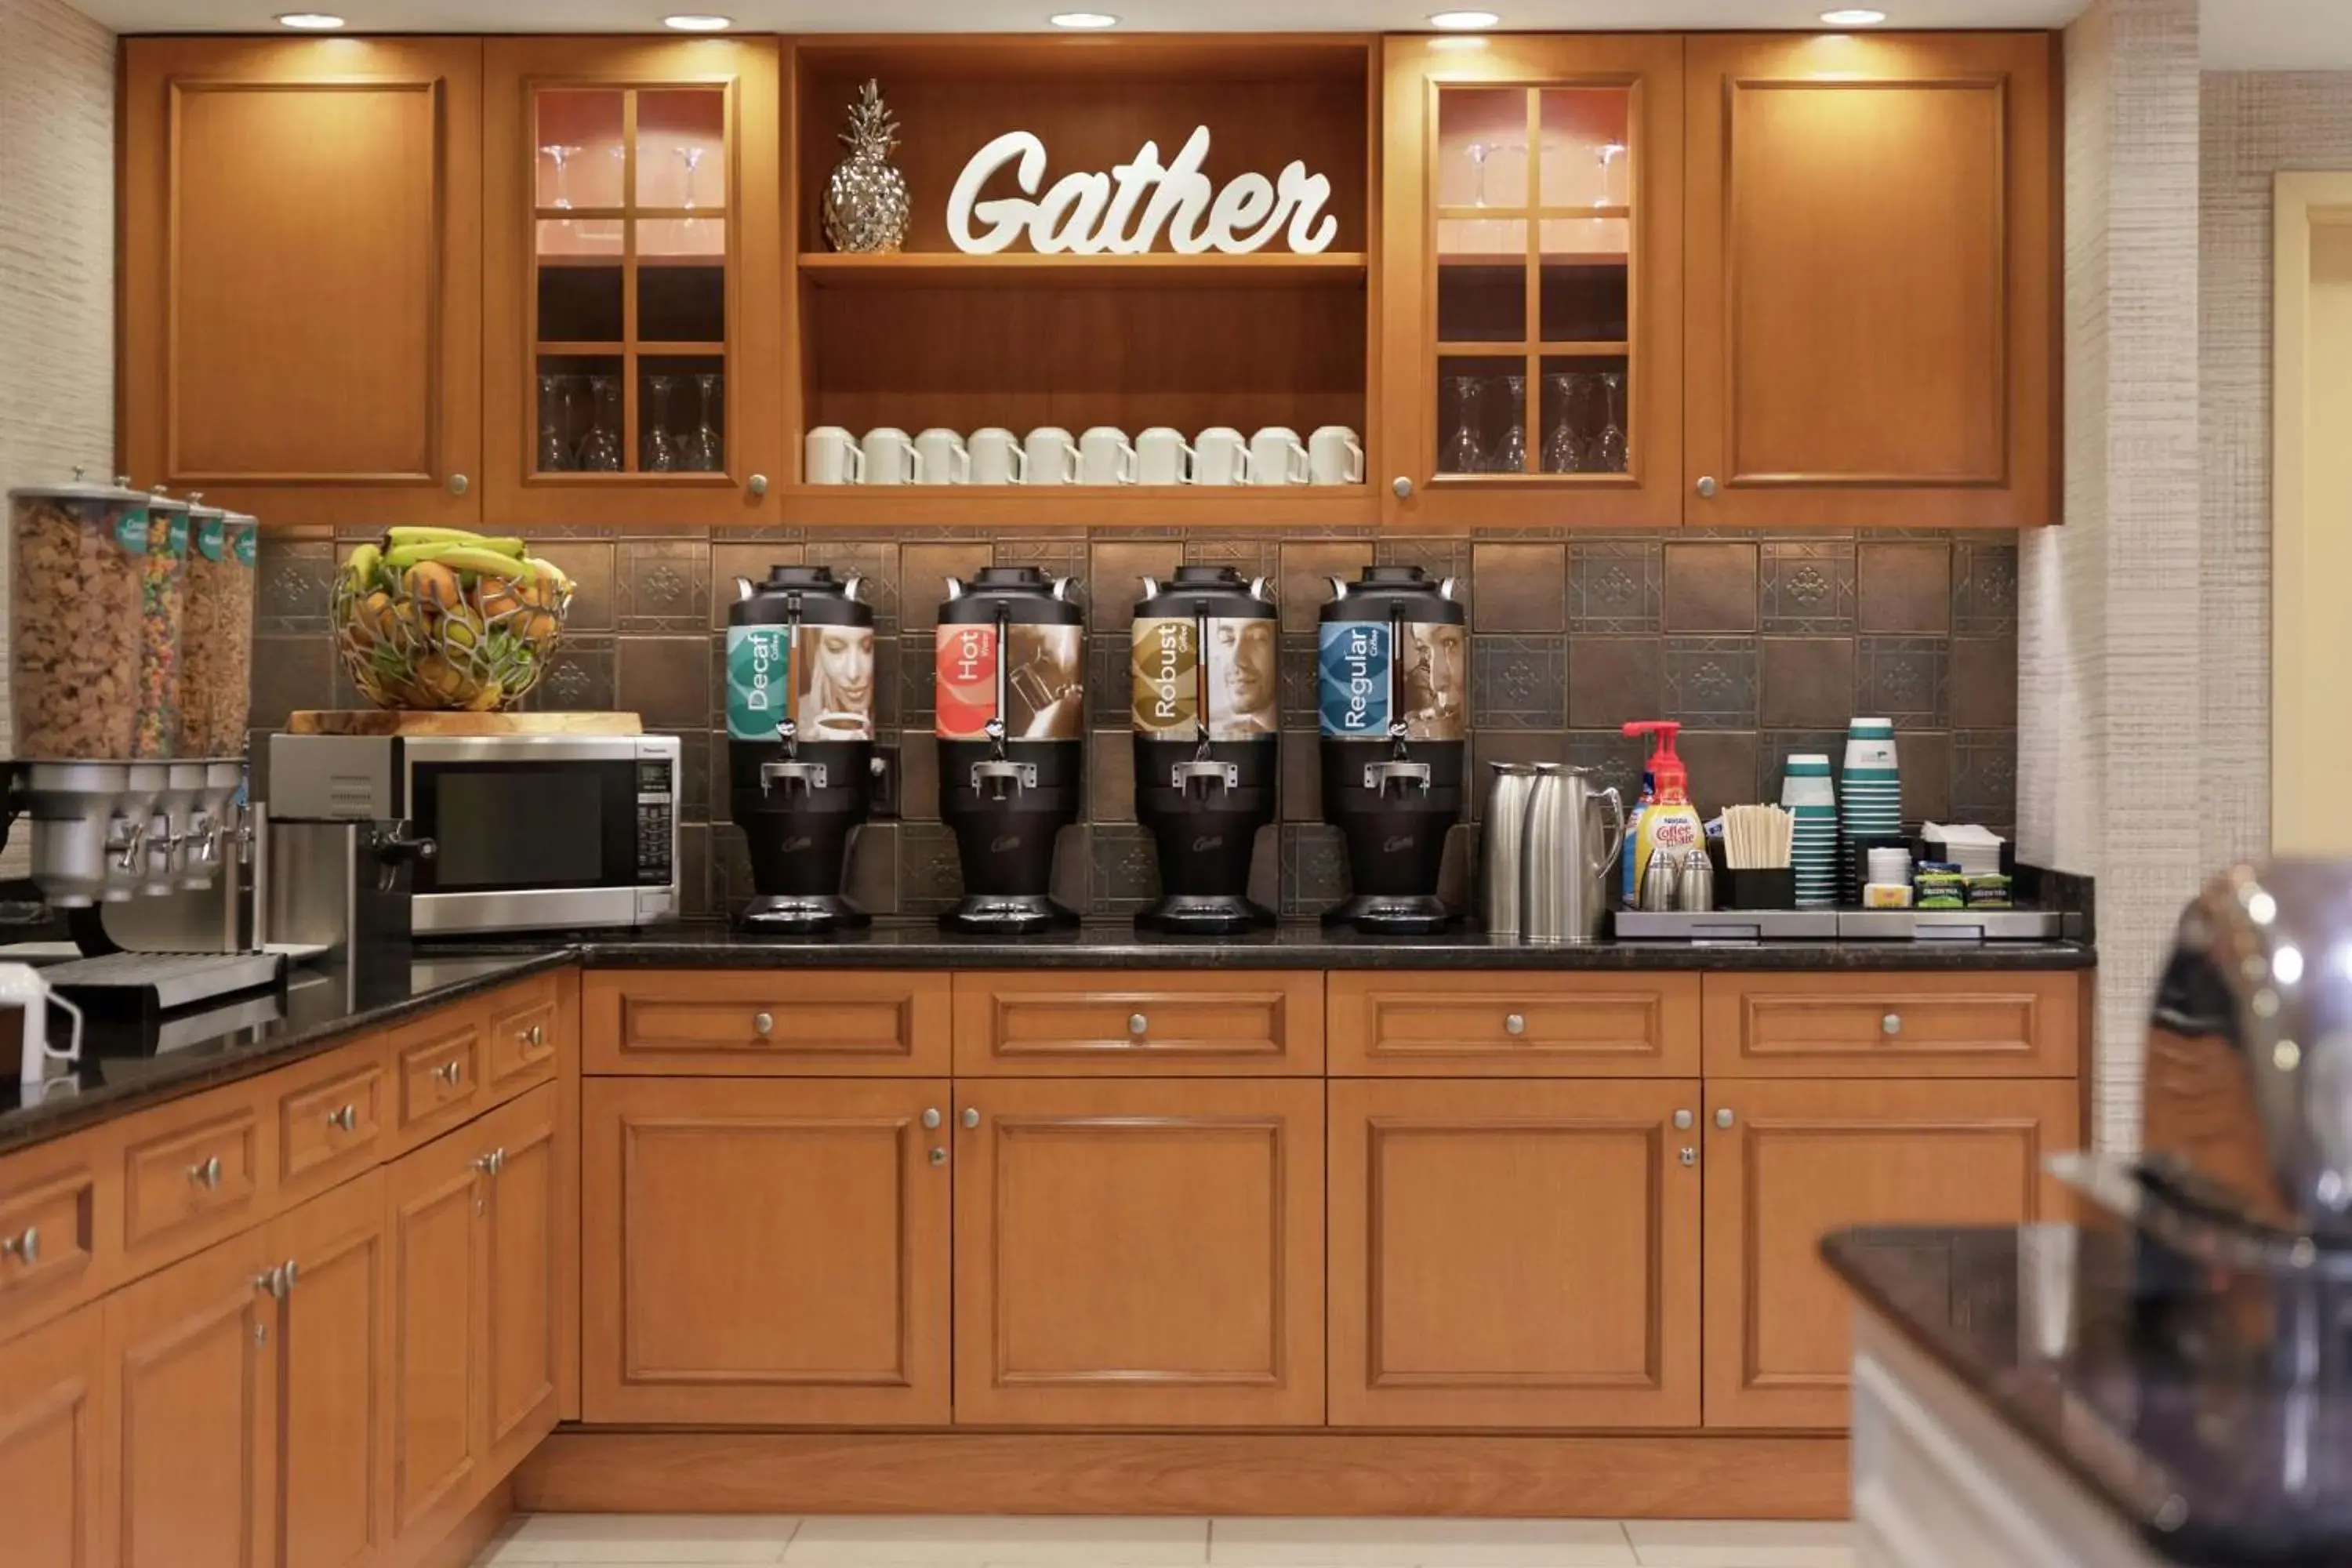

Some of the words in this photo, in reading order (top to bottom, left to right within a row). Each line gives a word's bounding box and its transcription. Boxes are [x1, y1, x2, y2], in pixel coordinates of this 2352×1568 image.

[947, 125, 1337, 255] Gather
[747, 634, 768, 710] Decaf
[957, 631, 978, 680] Hot
[1155, 625, 1177, 717] Robust
[1345, 629, 1373, 728] Regular
